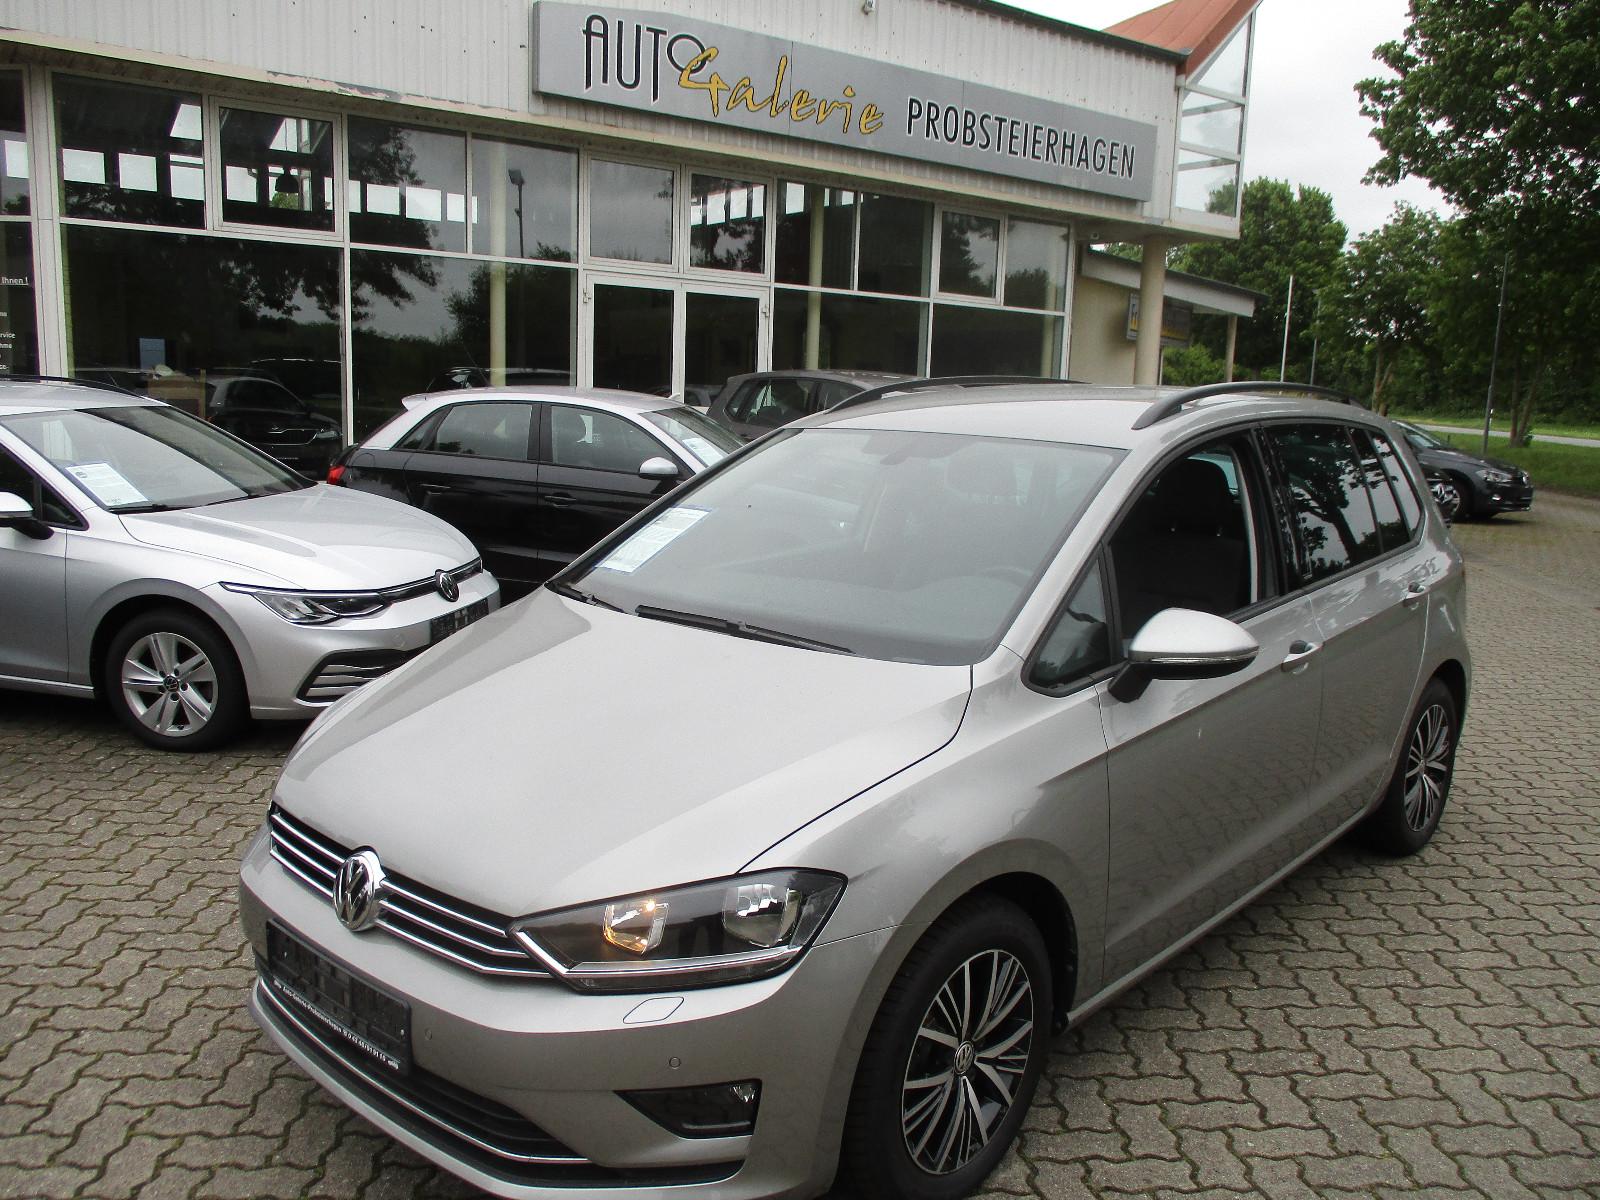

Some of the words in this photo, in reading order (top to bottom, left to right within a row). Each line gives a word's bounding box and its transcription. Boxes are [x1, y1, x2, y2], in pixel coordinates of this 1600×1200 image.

[582, 13, 708, 103] AUTO
[678, 46, 884, 135] Galerie
[905, 96, 1137, 179] PROBSTEIERHAGEN
